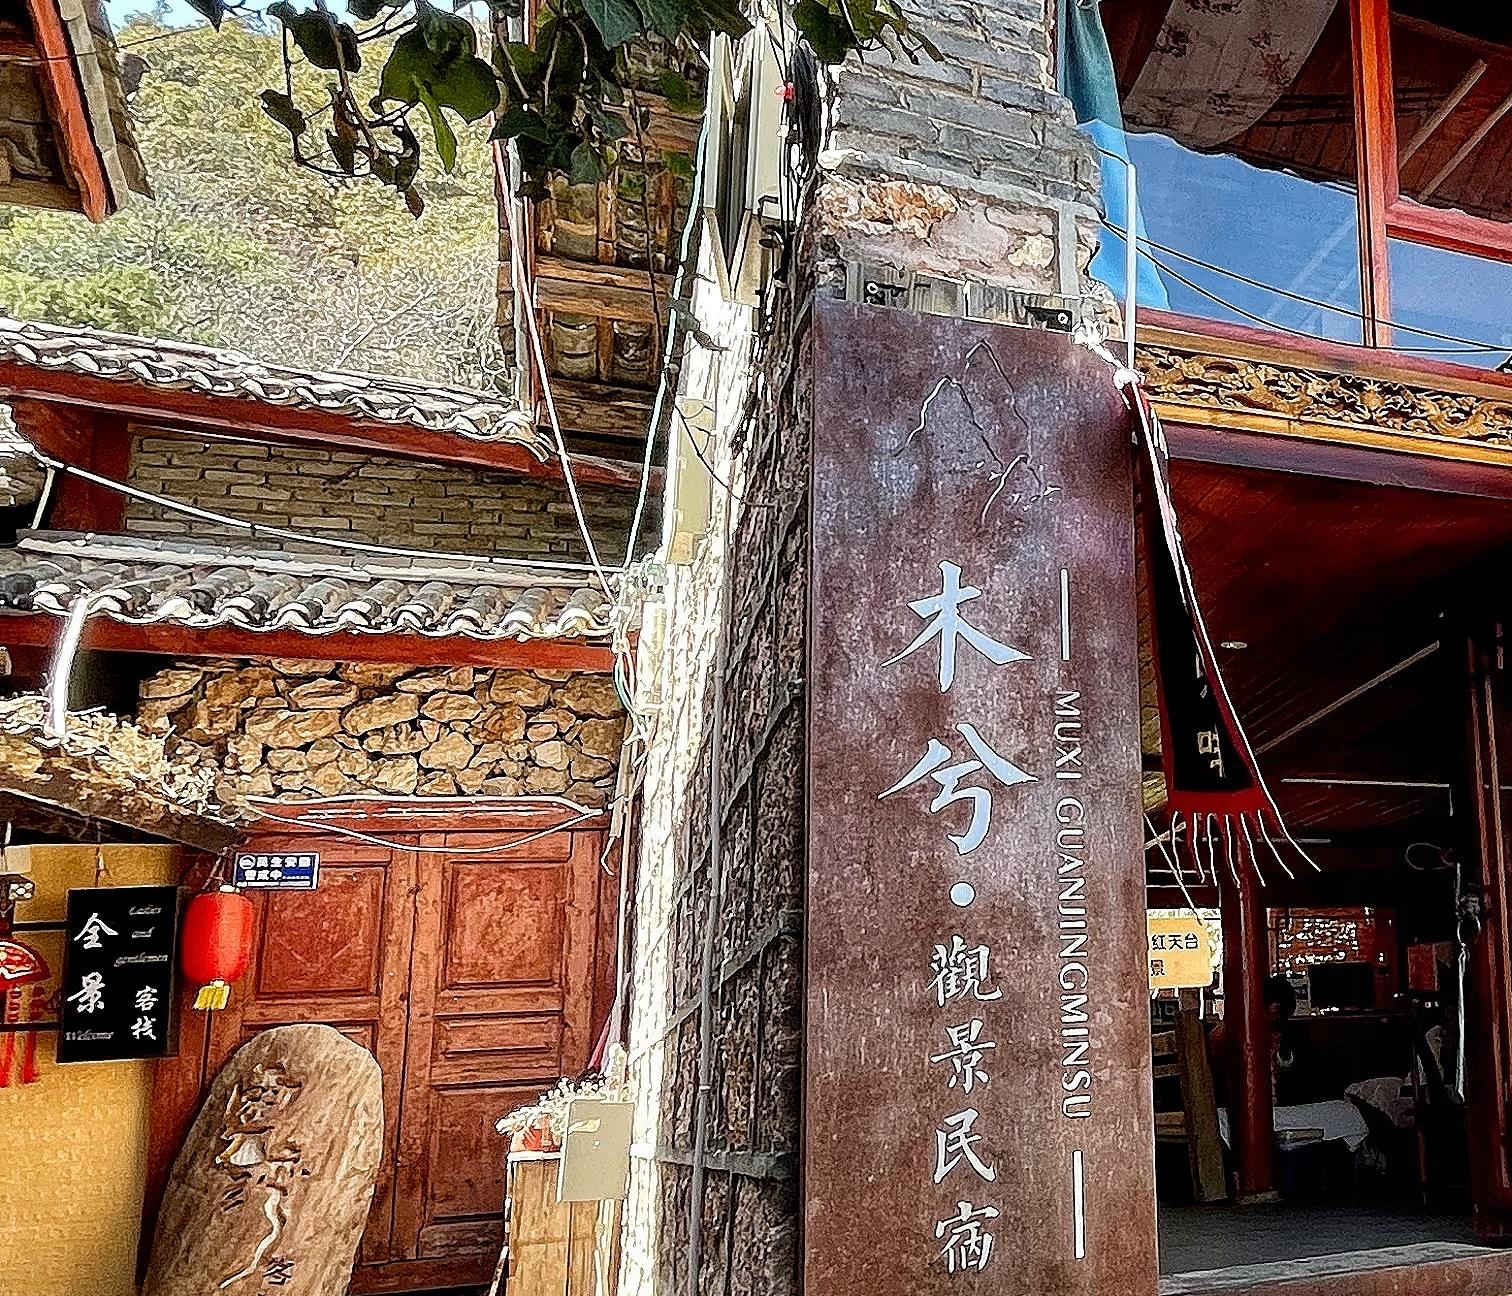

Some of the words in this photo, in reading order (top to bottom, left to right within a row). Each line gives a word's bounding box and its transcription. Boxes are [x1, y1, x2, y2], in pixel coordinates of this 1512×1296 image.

[1054, 690, 1083, 781] MUXI
[66, 912, 119, 1014] 全景
[1055, 797, 1093, 1120] GUANJINGMINSU
[1150, 933, 1199, 951] 红天台
